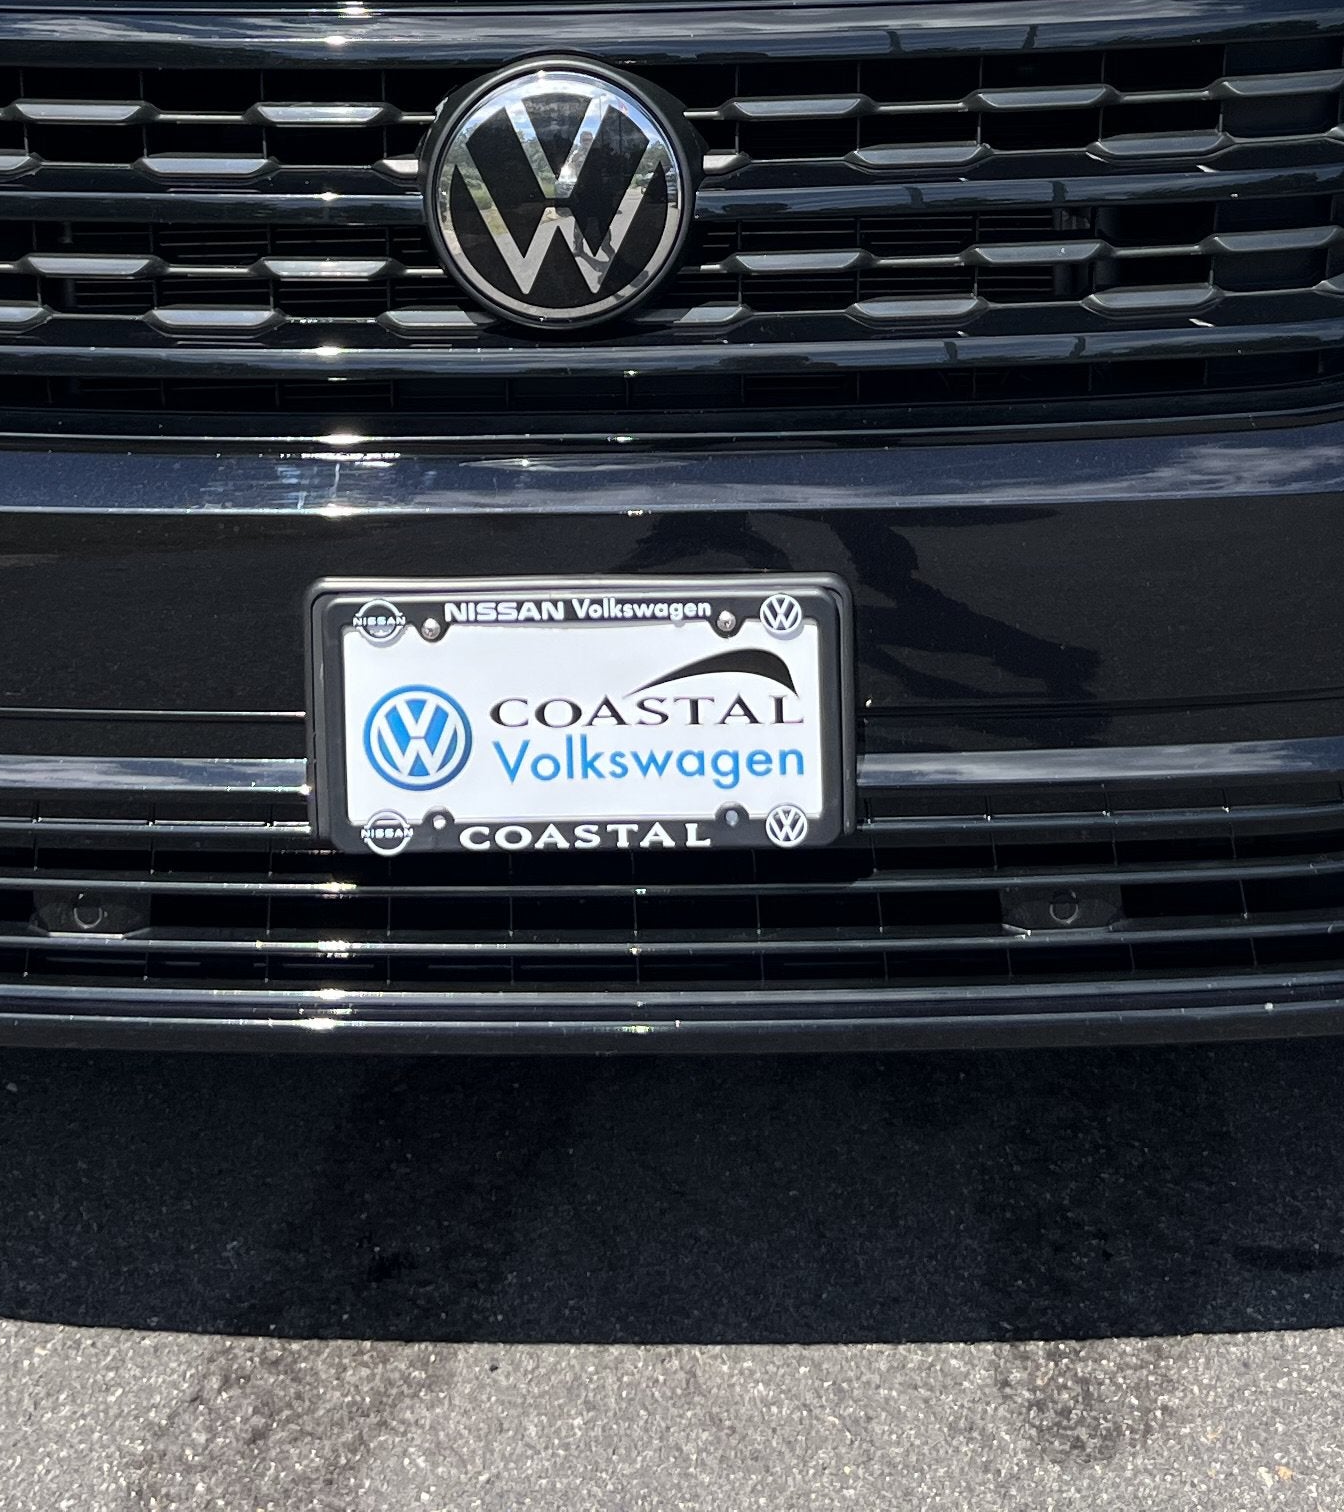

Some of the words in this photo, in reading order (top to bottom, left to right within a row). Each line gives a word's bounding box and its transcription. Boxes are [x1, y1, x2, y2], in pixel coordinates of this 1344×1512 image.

[352, 615, 406, 627] NISSAN
[444, 600, 565, 622] NISSAN
[572, 597, 712, 619] Volkswagen
[489, 692, 805, 728] COASTAL
[492, 733, 805, 789] Volkswagen
[360, 828, 414, 839] NISSAN
[459, 821, 712, 851] COASTAL
